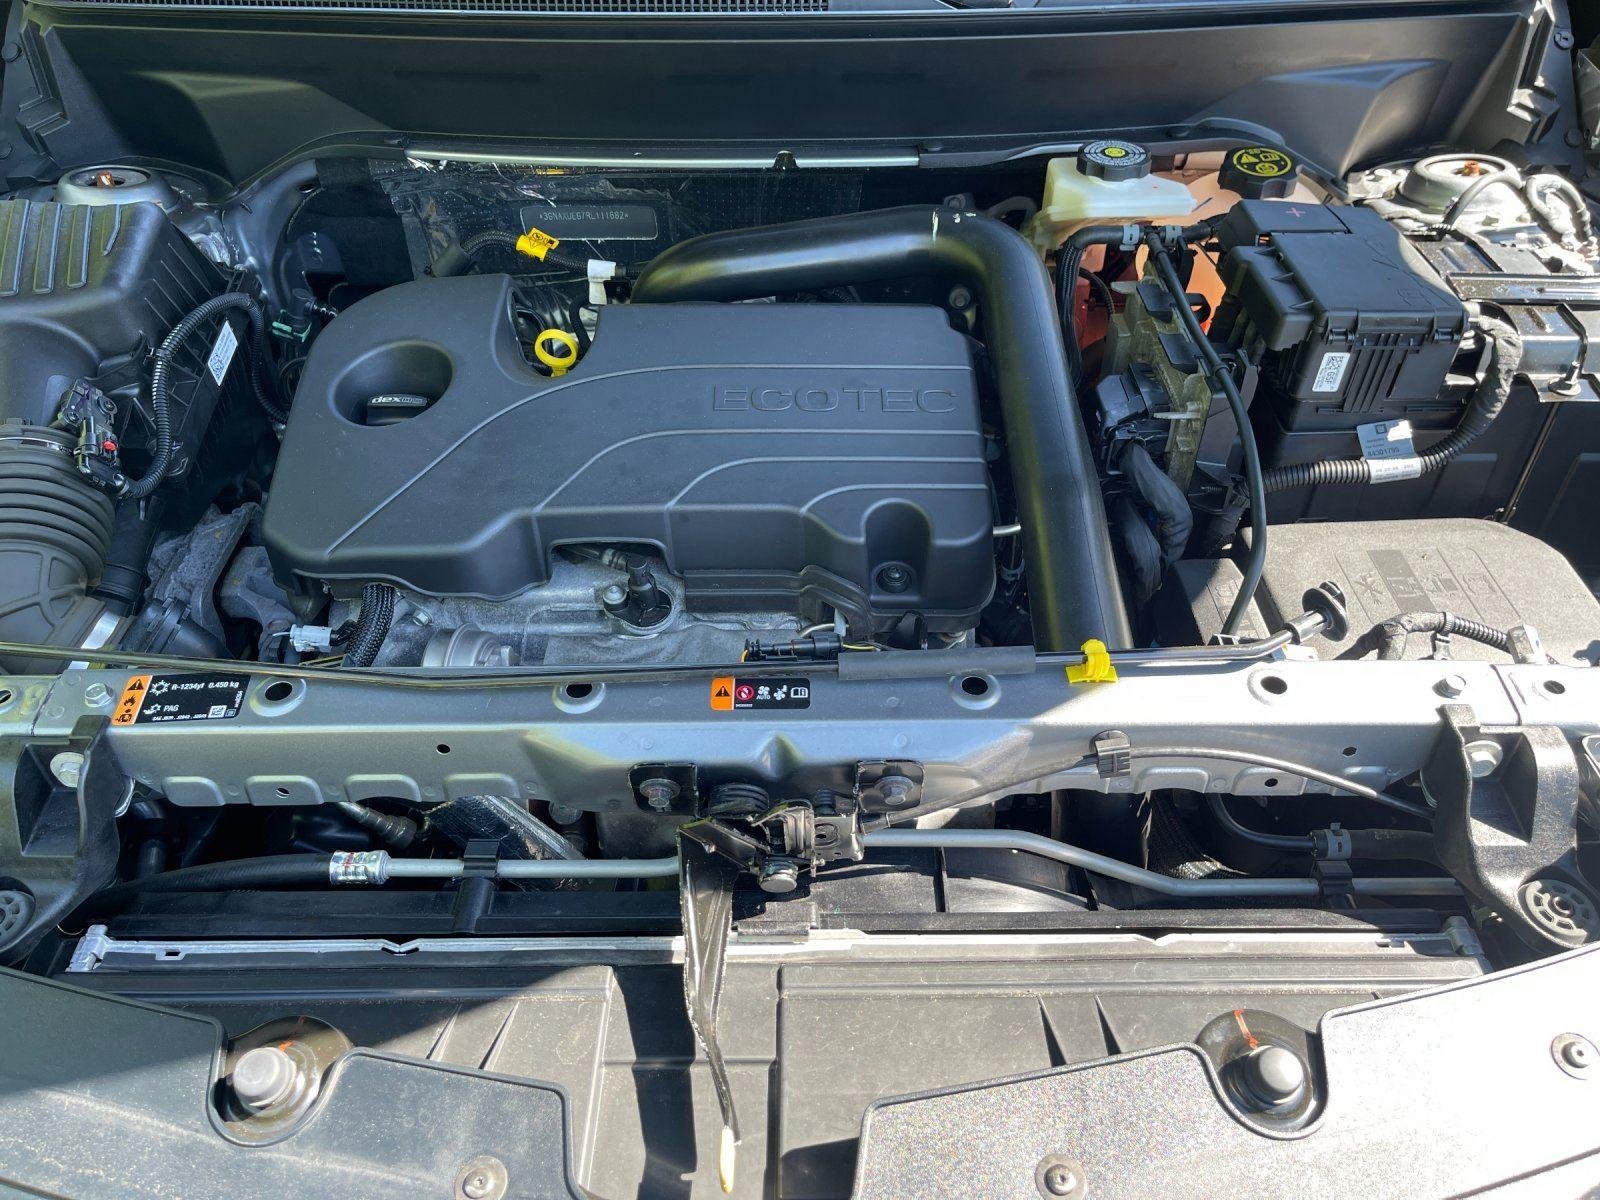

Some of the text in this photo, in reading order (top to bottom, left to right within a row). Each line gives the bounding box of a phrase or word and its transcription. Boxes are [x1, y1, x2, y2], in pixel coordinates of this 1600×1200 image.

[713, 384, 959, 413] ECOTEC
[171, 682, 205, 691] R-1234yf
[229, 681, 240, 689] kg
